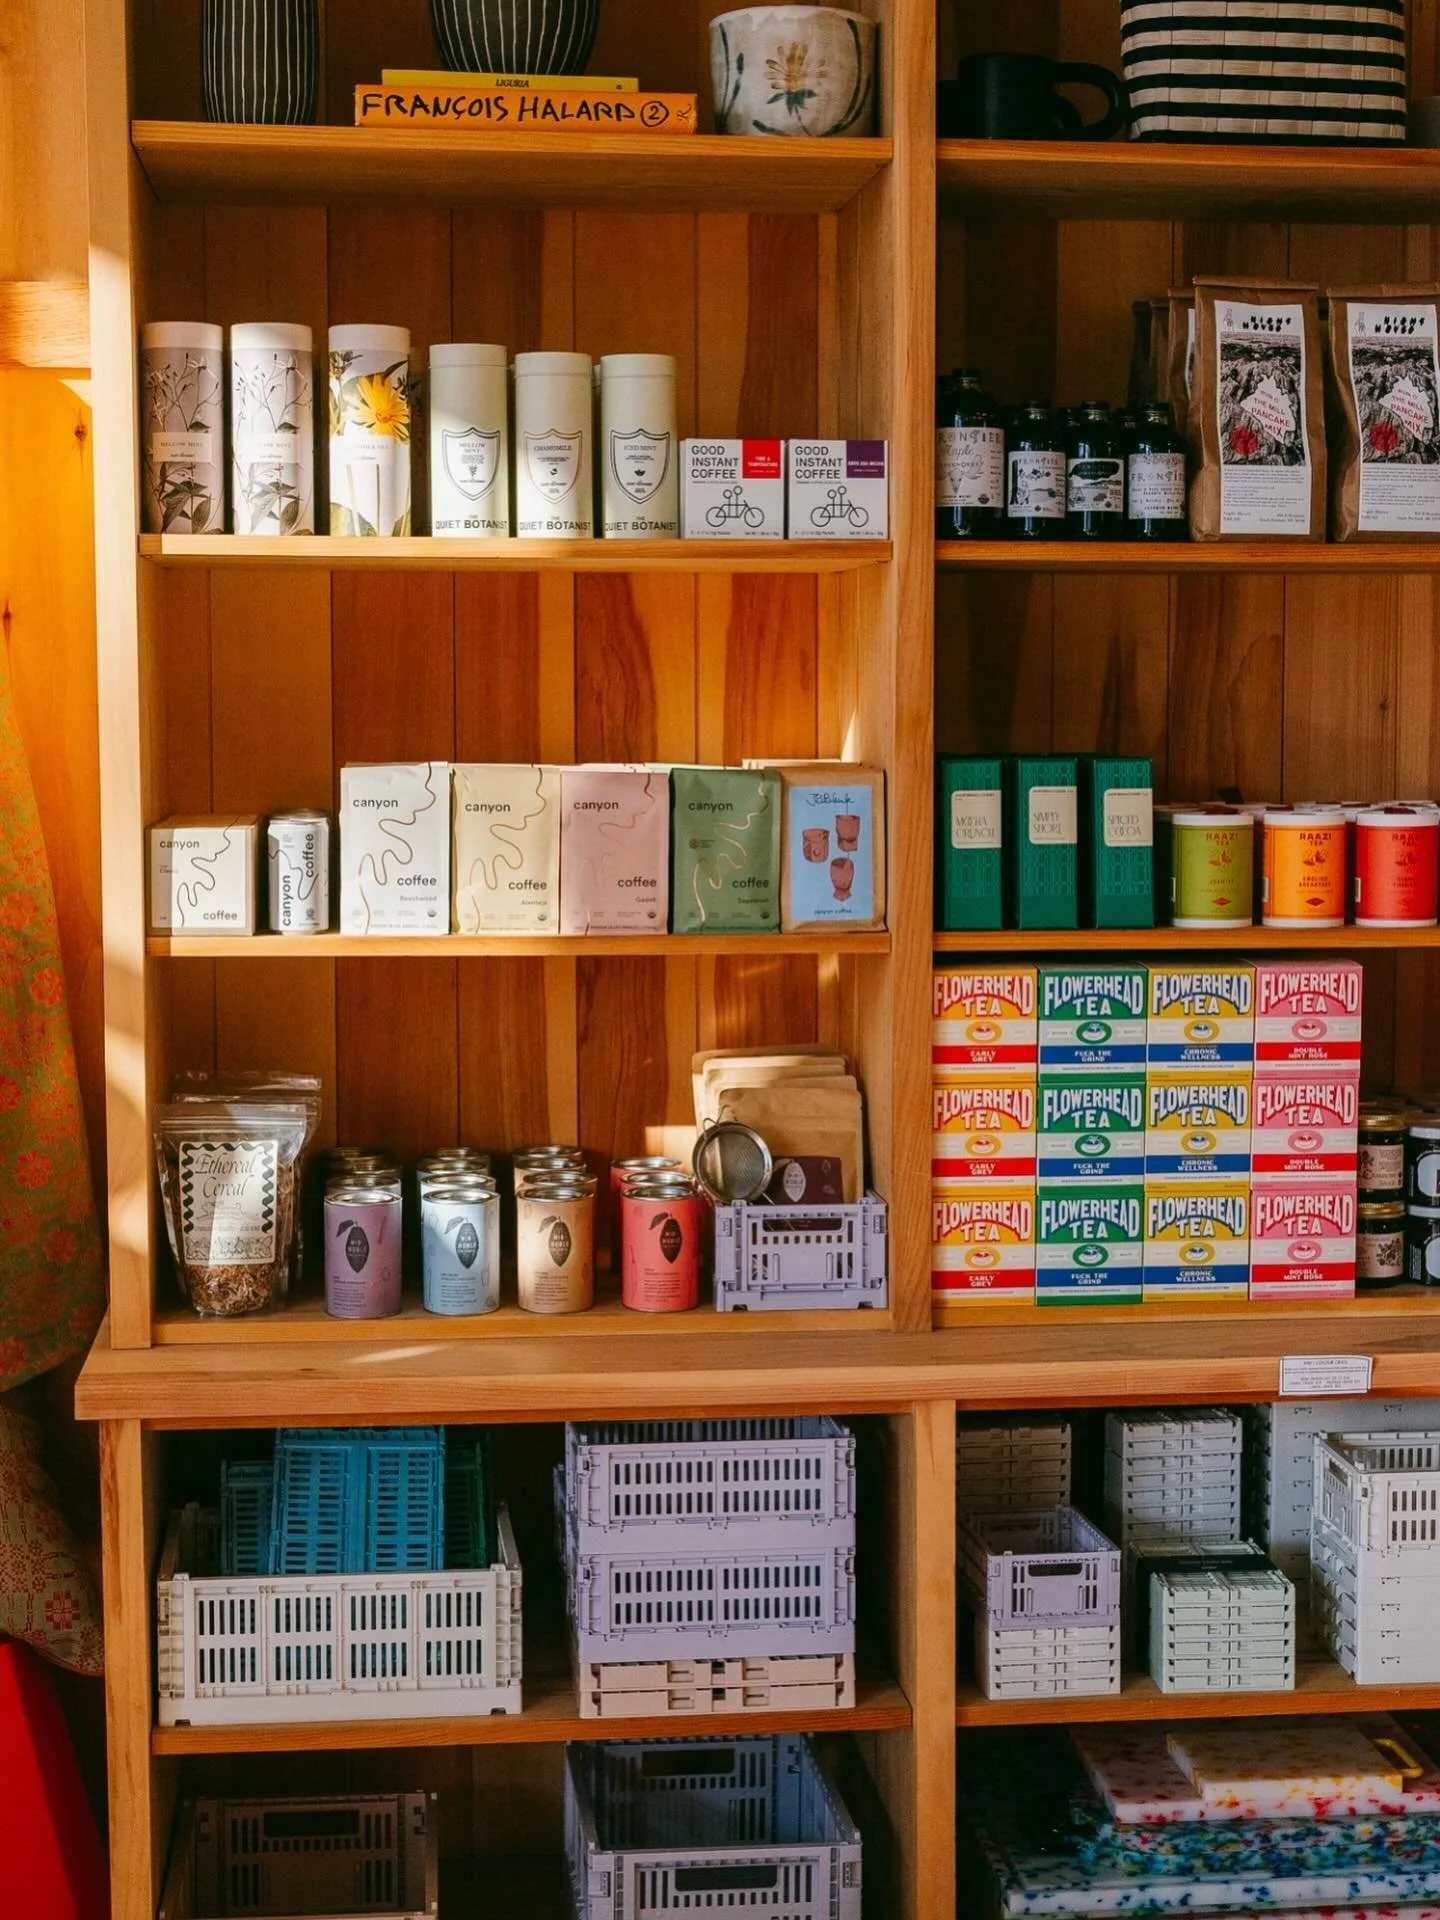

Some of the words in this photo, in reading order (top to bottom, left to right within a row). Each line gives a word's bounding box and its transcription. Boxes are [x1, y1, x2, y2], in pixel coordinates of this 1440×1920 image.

[494, 79, 530, 89] LIGURIA
[362, 93, 509, 122] FRANÇOIS
[691, 445, 725, 456] GOOD
[795, 446, 829, 456] GOOD
[692, 457, 739, 467] INSTANT
[795, 457, 843, 467] INSTANT
[691, 469, 736, 479] COFFEE
[795, 469, 841, 479] COFFEE
[435, 520, 461, 531] QUIET
[464, 519, 508, 531] BOTANIST
[519, 521, 544, 531] QUIET
[546, 520, 591, 532] BOTANIST
[631, 521, 677, 532] BOTANIST
[352, 799, 399, 810] canyon
[465, 803, 511, 814] canyon
[573, 801, 619, 812] canyon
[688, 801, 733, 813] canyon
[160, 839, 200, 850] canyon
[1299, 833, 1332, 841] RAAZI
[302, 833, 315, 878] coffee
[396, 875, 437, 887] coffee
[508, 879, 547, 891] coffee
[617, 876, 657, 888] coffee
[732, 877, 769, 889] coffee
[282, 875, 294, 926] canyon
[202, 910, 238, 921] coffee
[933, 975, 1034, 1017] FLOWERHEAD
[1044, 976, 1144, 1016] FLOWERHEAD
[1153, 974, 1251, 1015] FLOWERHEAD
[1260, 973, 1360, 1015] FLOWERHEAD
[963, 997, 1003, 1016] TEA
[1073, 997, 1112, 1016] TEA
[1181, 996, 1220, 1015] TEA
[1288, 994, 1328, 1015] TEA
[933, 1087, 1033, 1129] FLOWERHEAD
[1043, 1087, 1142, 1129] FLOWERHEAD
[1150, 1085, 1249, 1127] FLOWERHEAD
[1255, 1084, 1355, 1127] FLOWERHEAD
[962, 1109, 1001, 1129] TEA
[1071, 1109, 1110, 1128] TEA
[1178, 1106, 1217, 1126] TEA
[1284, 1106, 1324, 1126] TEA
[195, 1152, 263, 1175] Ethereal
[203, 1175, 254, 1198] Cereal
[932, 1200, 1032, 1241] FLOWERHEAD
[1041, 1199, 1140, 1239] FLOWERHEAD
[1148, 1196, 1246, 1238] FLOWERHEAD
[1255, 1195, 1353, 1236] FLOWERHEAD
[962, 1222, 1000, 1241] TEA
[1069, 1219, 1109, 1239] TEA
[1176, 1218, 1216, 1238] TEA
[1283, 1215, 1323, 1236] TEA
